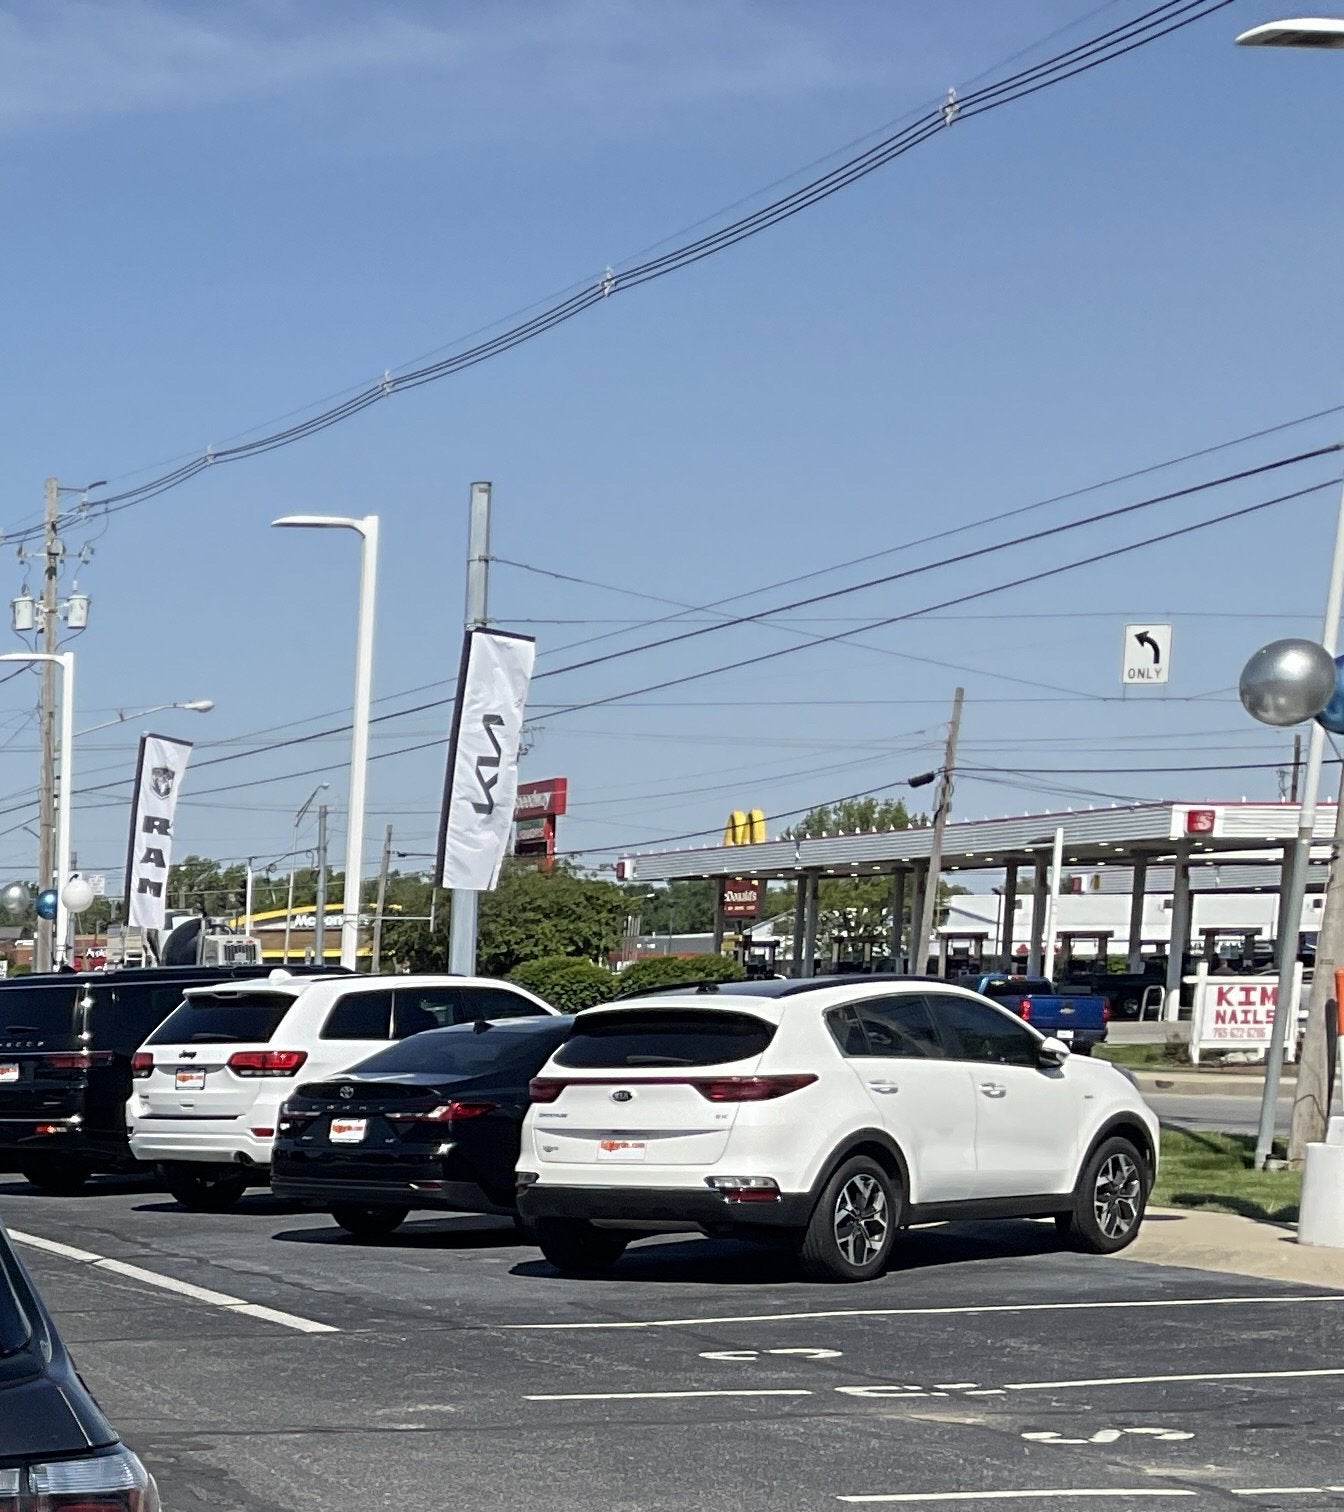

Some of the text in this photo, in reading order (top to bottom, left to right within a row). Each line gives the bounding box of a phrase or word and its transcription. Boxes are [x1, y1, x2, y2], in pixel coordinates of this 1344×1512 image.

[1128, 668, 1162, 679] ONLY
[137, 815, 173, 898] RAM
[1216, 986, 1279, 1006] KIM
[1215, 1009, 1275, 1025] NAILS
